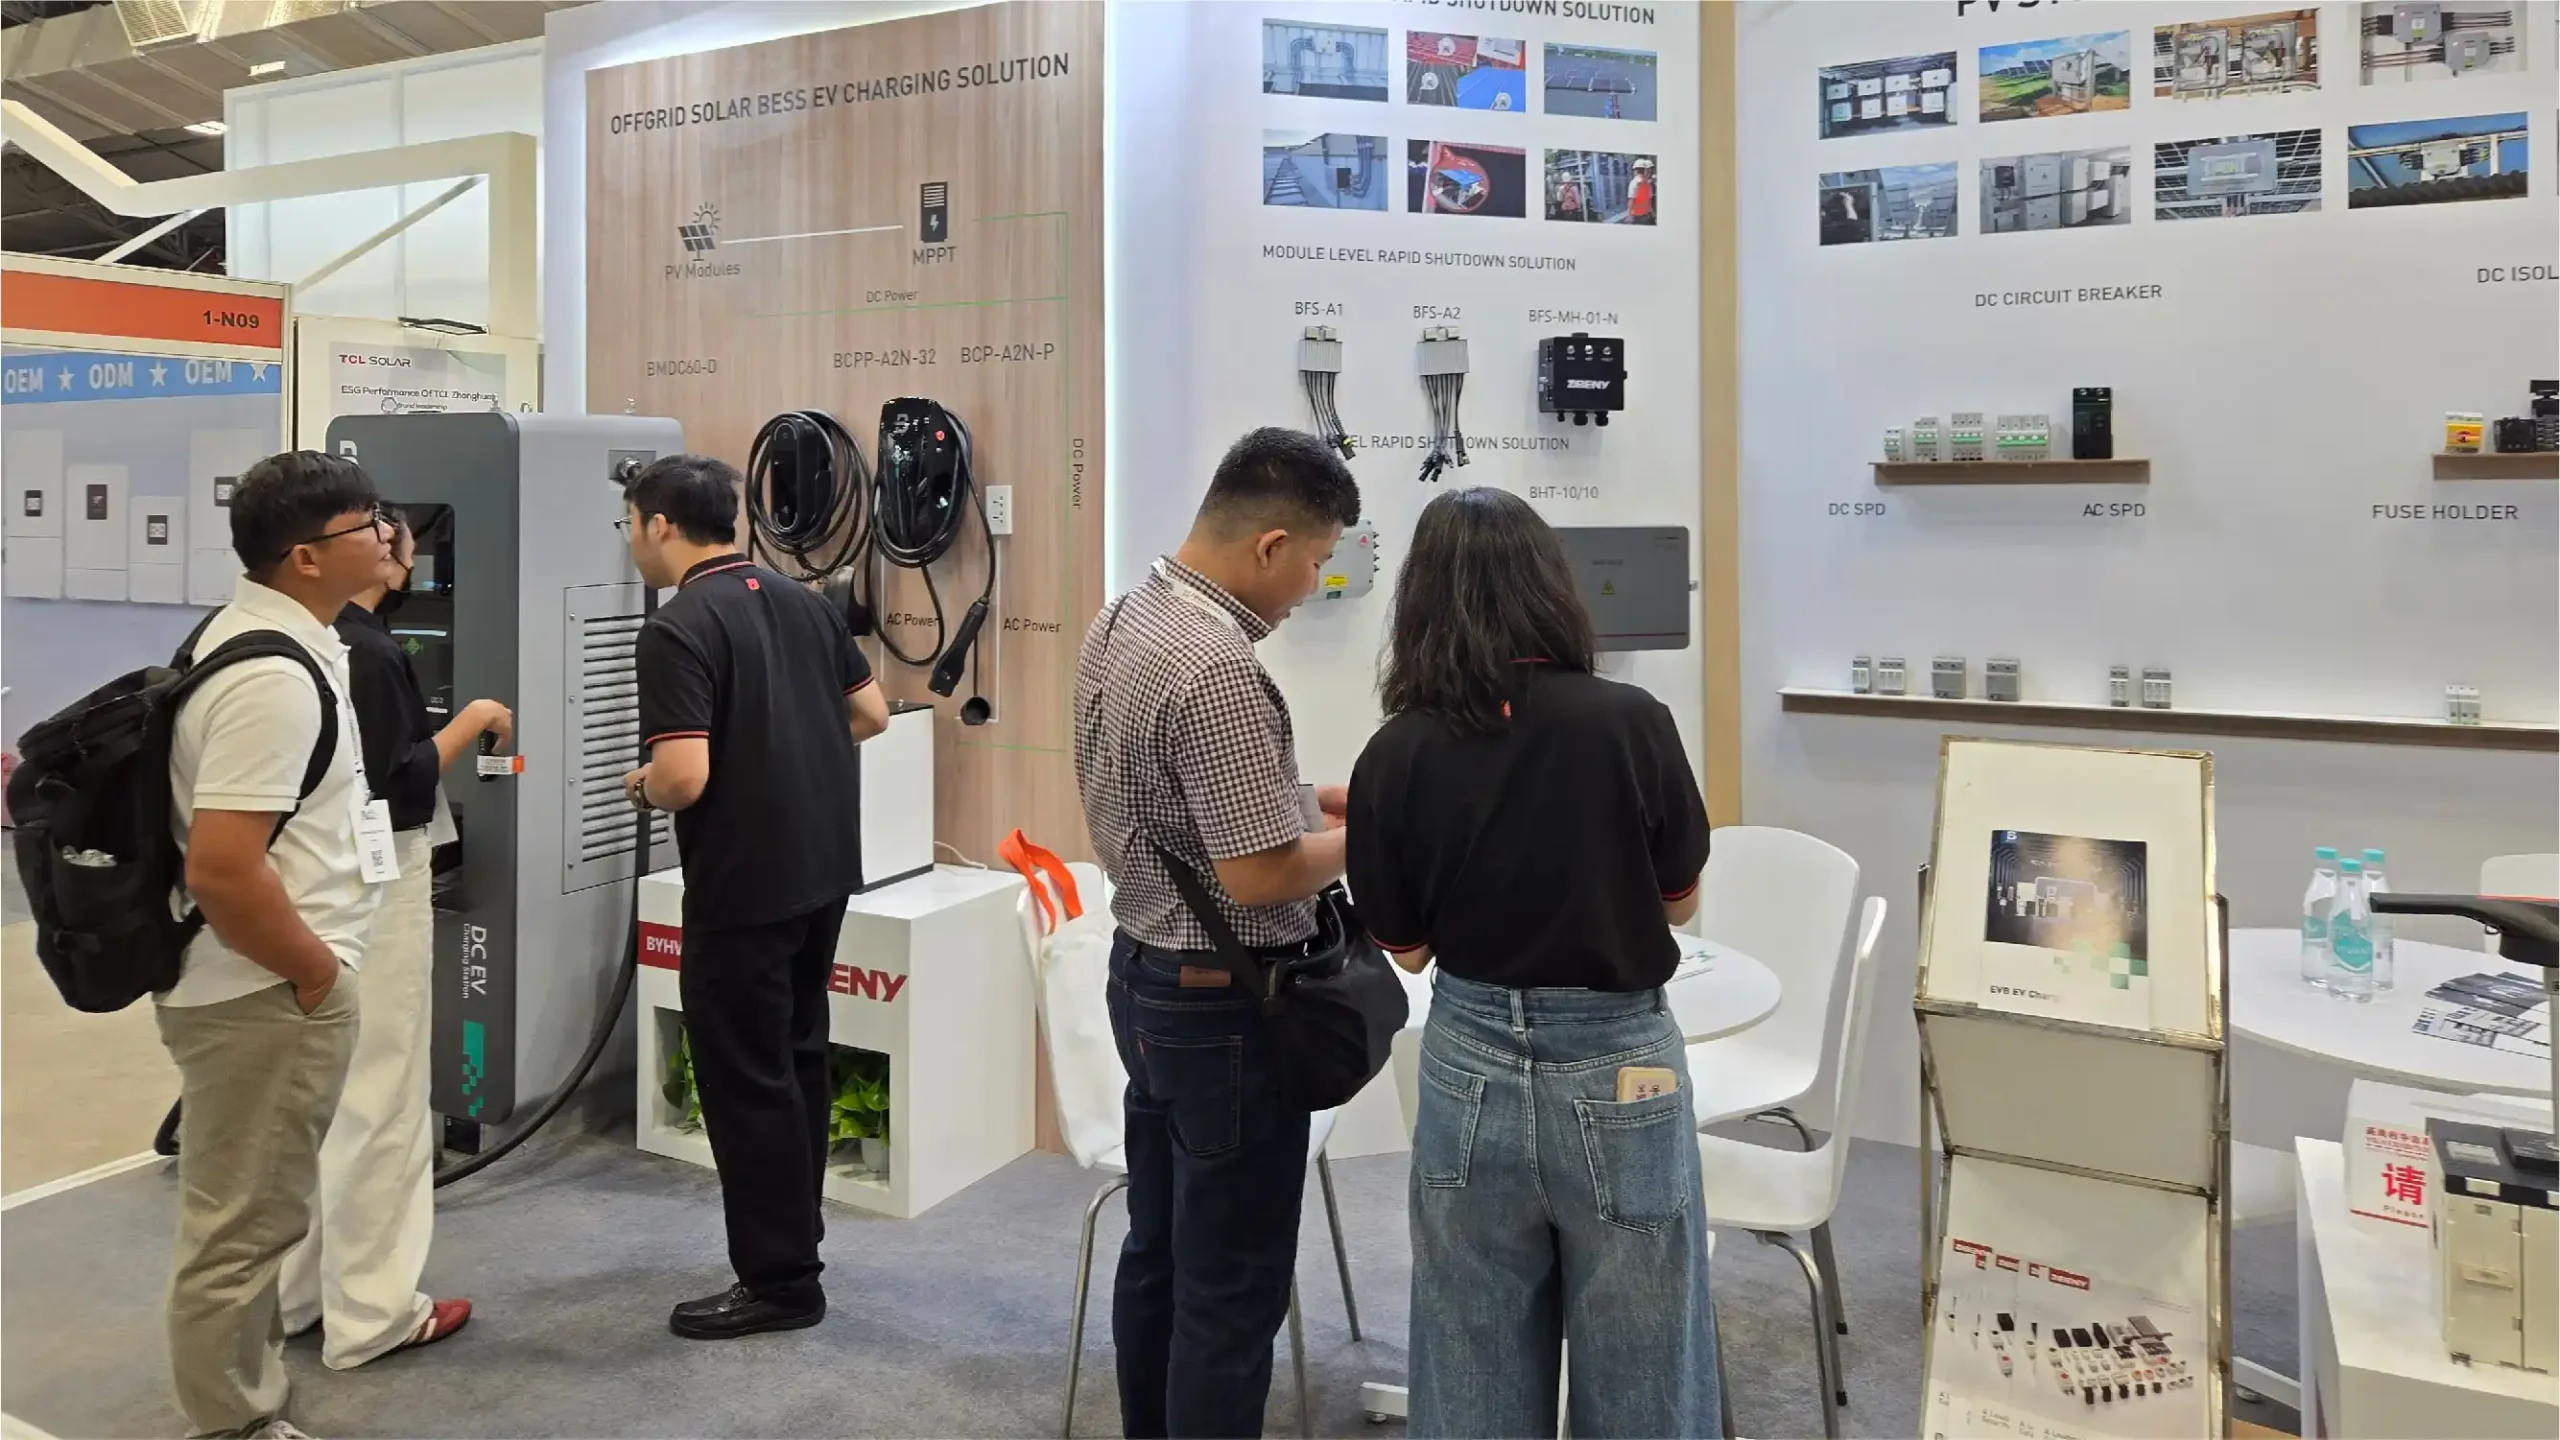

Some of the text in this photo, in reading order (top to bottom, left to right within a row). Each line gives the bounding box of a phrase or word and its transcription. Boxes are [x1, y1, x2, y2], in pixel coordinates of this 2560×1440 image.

[1562, 1, 1655, 25] SOLUTION
[611, 52, 1069, 135] OFFGRID SOLAR BESS EV CHARGING SOLUTION
[913, 247, 957, 266] MPPT
[1263, 245, 1576, 271] MODULE LEVEL RAPID SHUTDOWN SOLUTION
[665, 262, 741, 280] PV Modules
[2477, 265, 2559, 283] DC ISOL
[866, 289, 919, 303] DC Power
[1975, 284, 2163, 307] DC CIRCUIT BREAKER
[1295, 301, 1344, 316] BFS-A1
[1413, 305, 1461, 320] BFS-A2
[1528, 309, 1619, 325] BFS-MH-01-N
[203, 310, 259, 329] 1-N09
[338, 354, 411, 368] TCL SOLAR
[833, 349, 937, 369] BCPP-A2N-32
[961, 343, 1055, 363] BCP-A2N-P
[4, 360, 233, 394] OEM ODM OEM
[646, 359, 717, 377] BMDC60-D
[341, 385, 361, 395] ESG
[362, 386, 420, 398] Performance
[1372, 436, 1413, 449] RAPID
[1418, 436, 1498, 450] SHTOWN
[1502, 437, 1570, 450] SOLUTION
[1072, 438, 1084, 509] DC Power
[1530, 486, 1599, 500] BHT-10/10
[1828, 503, 1886, 516] DC SPD
[2083, 503, 2146, 517] AC SPD
[2372, 505, 2519, 520] FUSE HOLDER
[886, 613, 938, 627] AC Power
[1003, 618, 1062, 633] AC Power
[470, 926, 487, 995] DC EV
[826, 963, 908, 1003] ENY
[2381, 1162, 2427, 1206] 请
